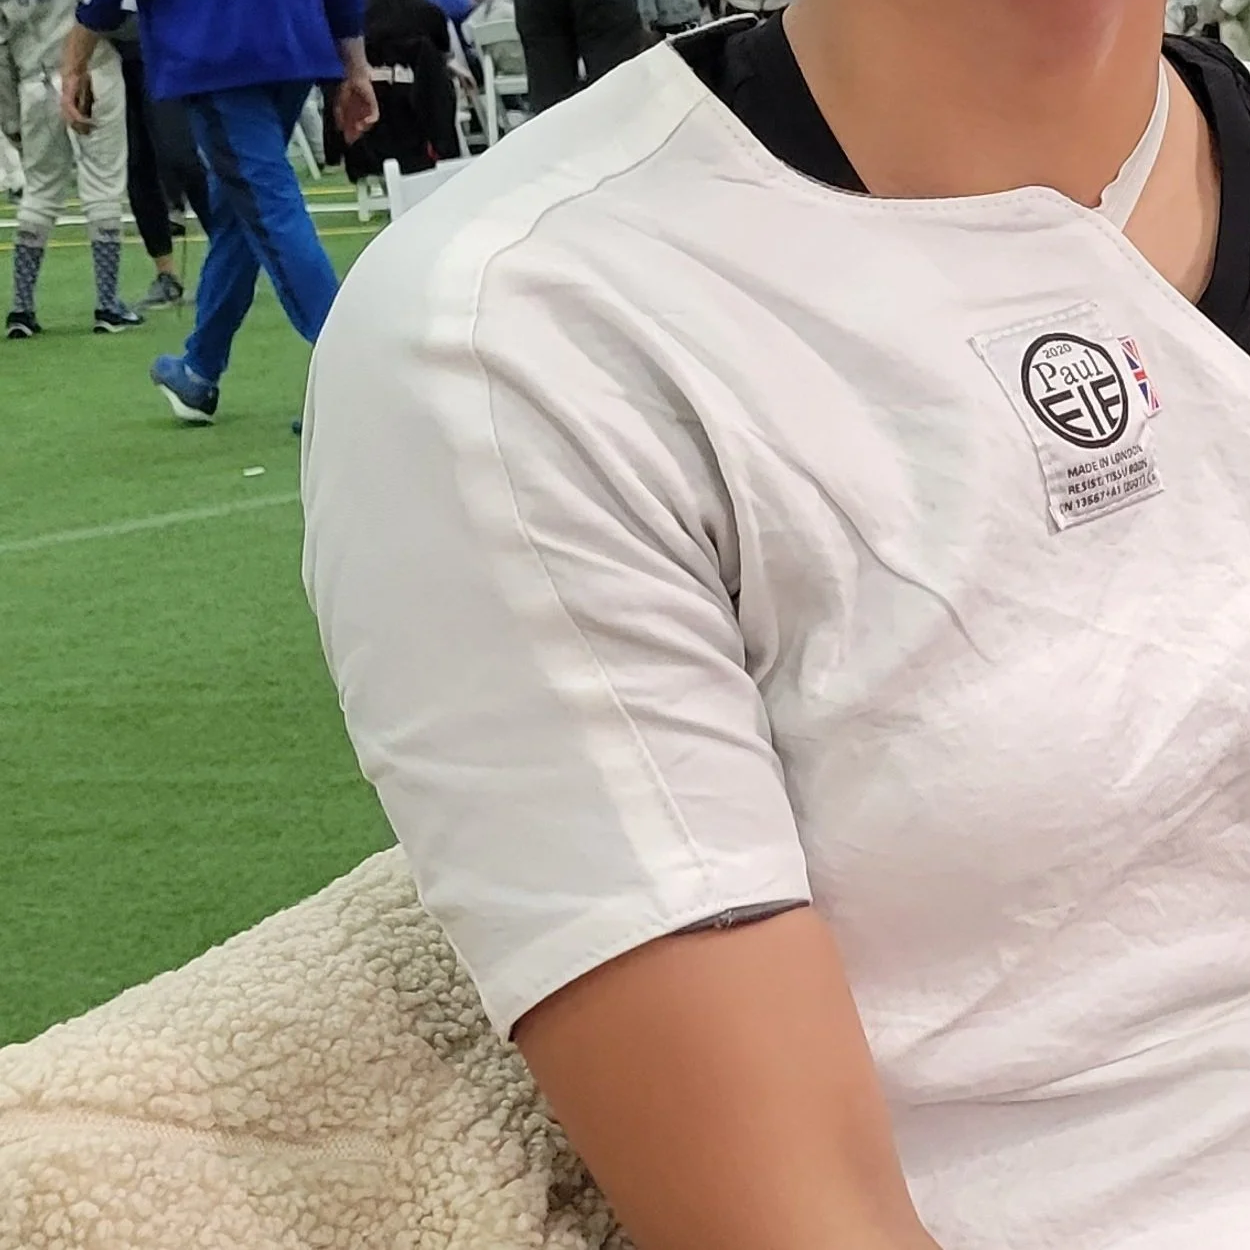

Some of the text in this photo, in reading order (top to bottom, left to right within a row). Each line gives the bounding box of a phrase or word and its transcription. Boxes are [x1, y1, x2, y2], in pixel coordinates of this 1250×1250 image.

[1042, 343, 1072, 359] 2020
[1032, 348, 1103, 393] Paul
[1067, 461, 1098, 479] MADE
[1099, 455, 1110, 469] IN
